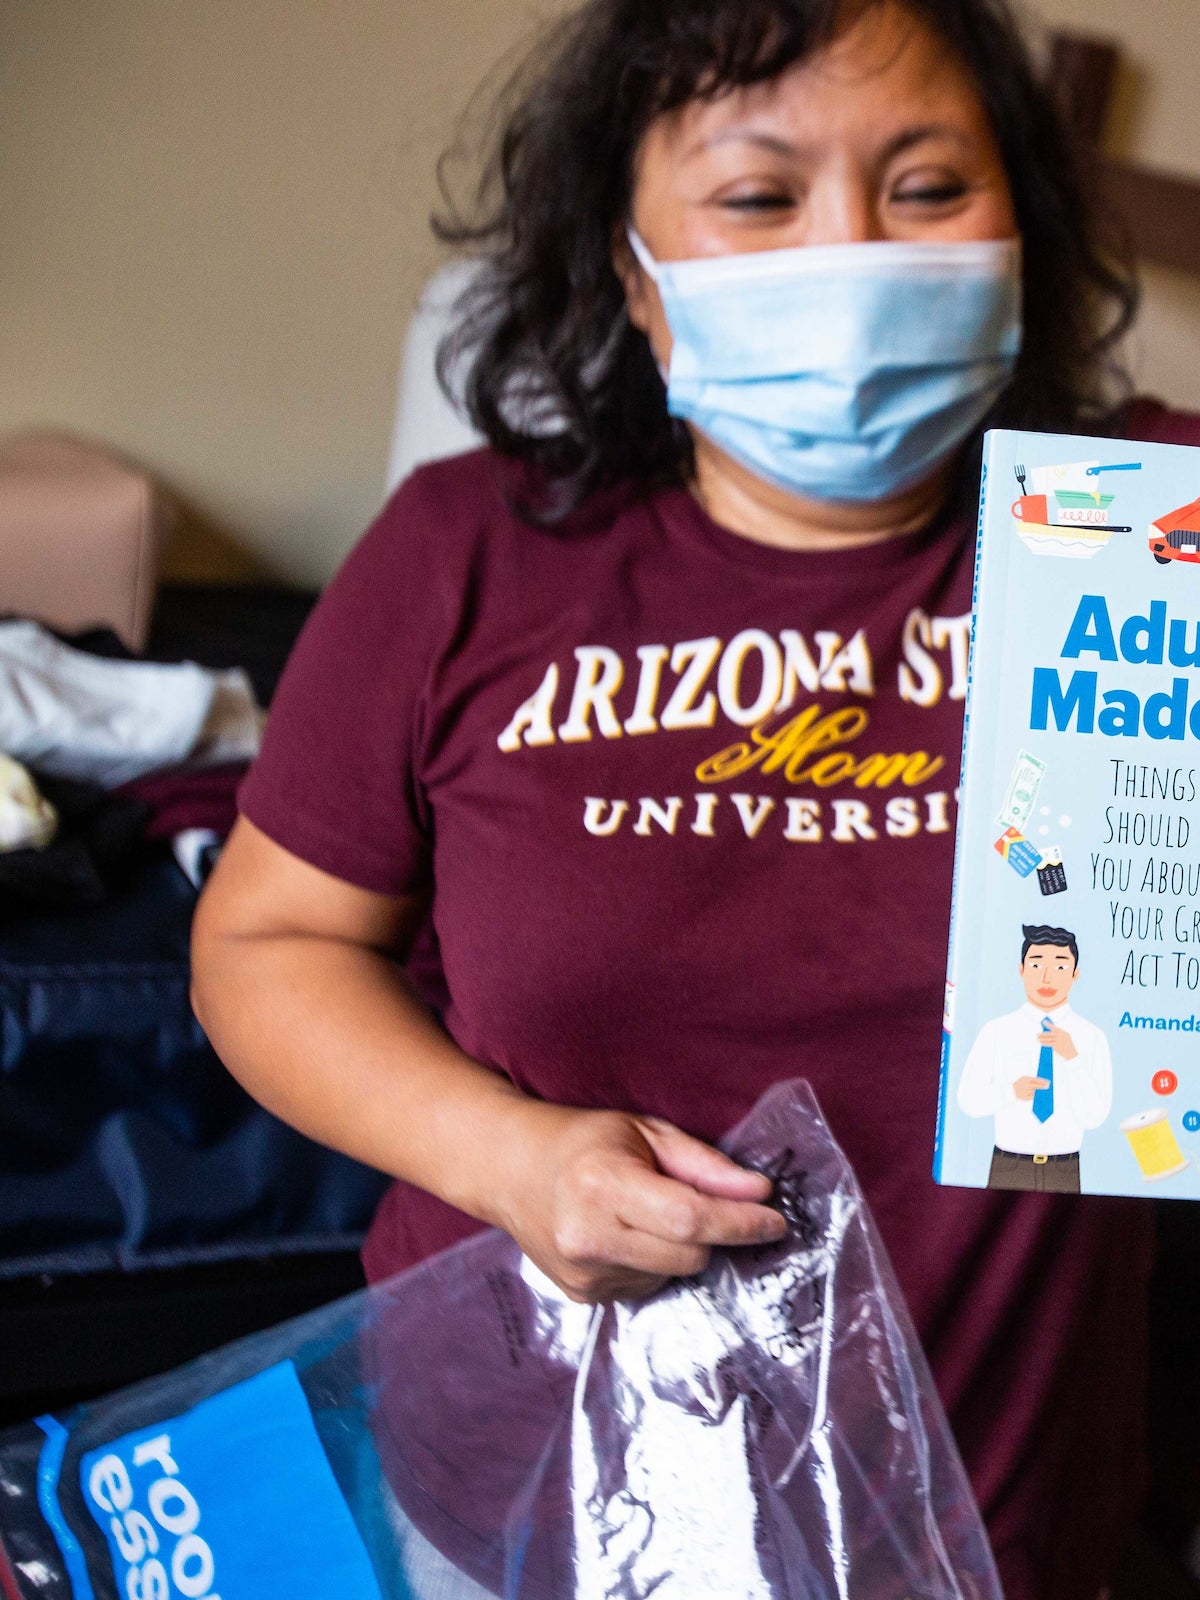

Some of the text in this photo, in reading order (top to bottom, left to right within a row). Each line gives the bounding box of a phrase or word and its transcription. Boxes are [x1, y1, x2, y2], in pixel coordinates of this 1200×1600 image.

[497, 628, 874, 752] ARIZONA
[694, 702, 945, 789] Mom
[1110, 760, 1195, 802] THINGS
[583, 787, 960, 842] UNIVERSI
[1104, 806, 1189, 848] SHOULD
[1091, 853, 1131, 892] YOU
[1110, 901, 1163, 941] YOUR
[1121, 950, 1163, 987] ACT
[133, 1434, 223, 1600] roo
